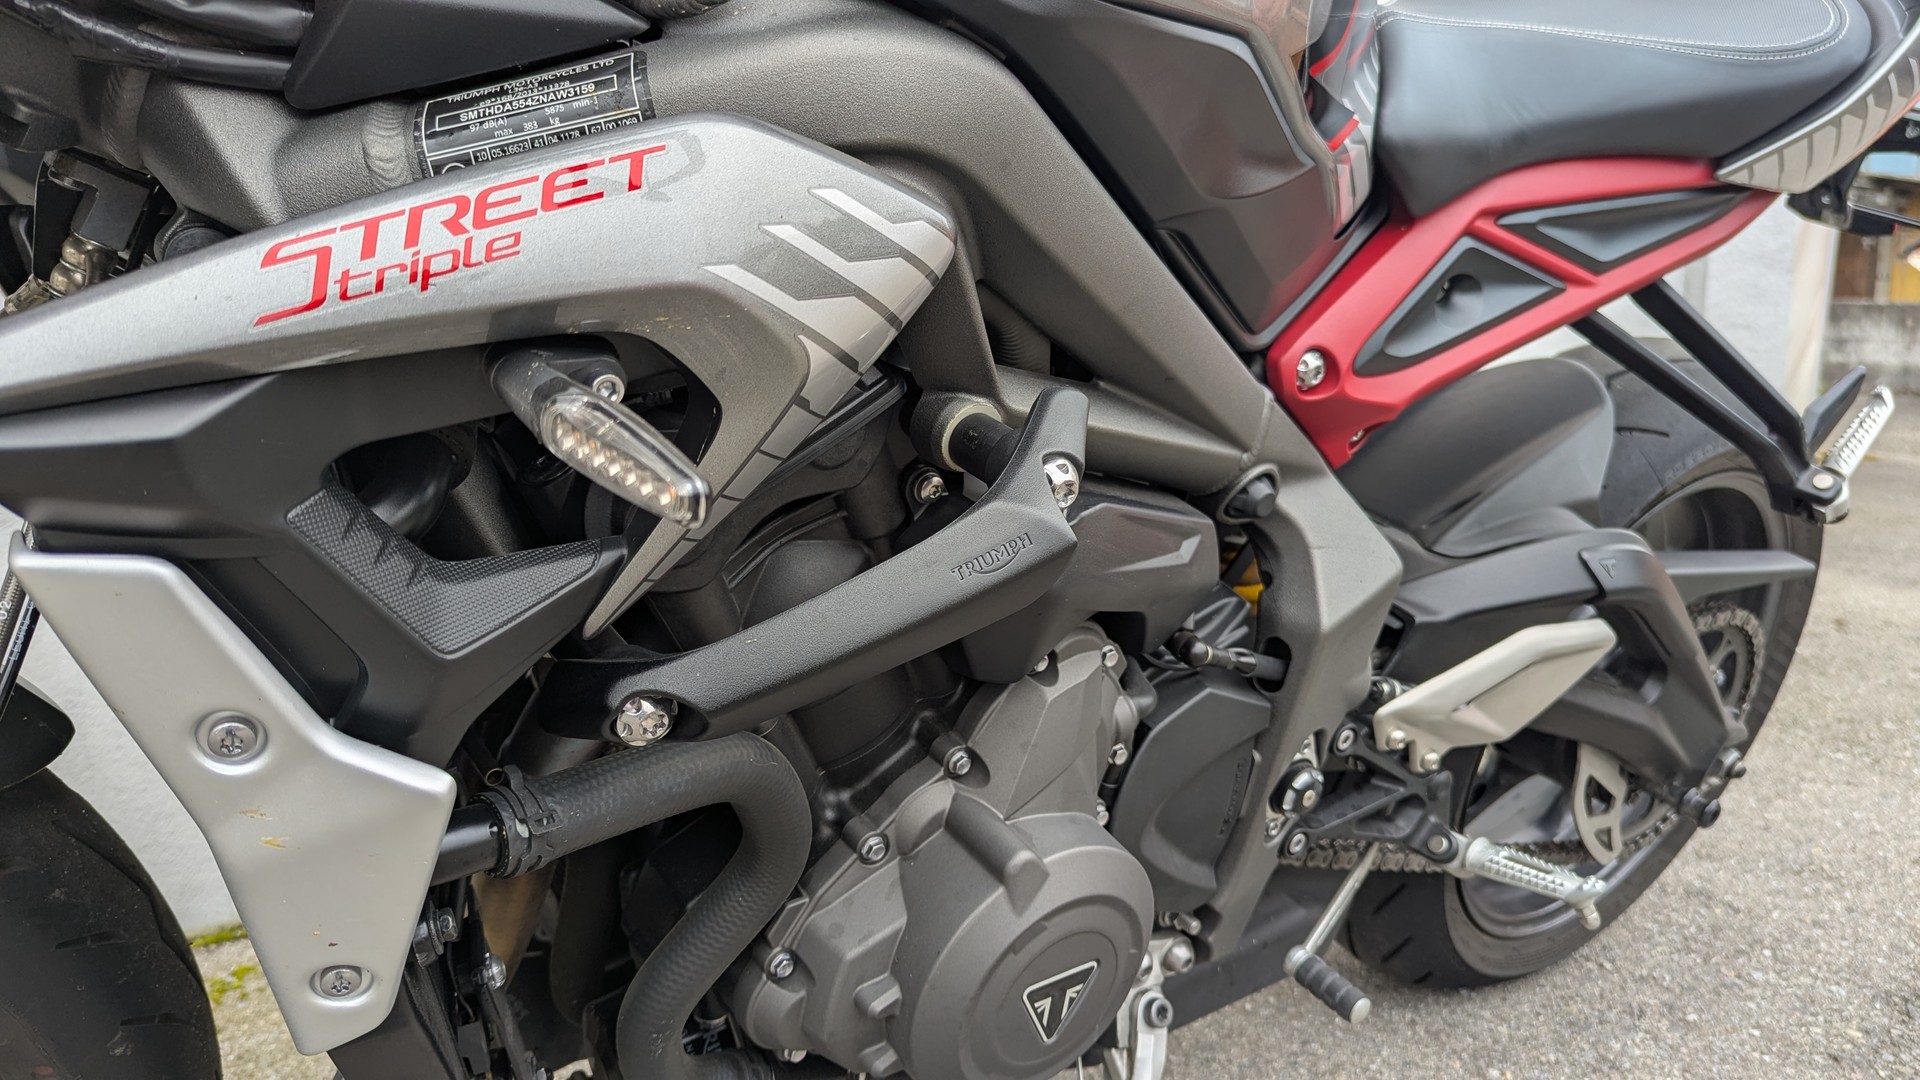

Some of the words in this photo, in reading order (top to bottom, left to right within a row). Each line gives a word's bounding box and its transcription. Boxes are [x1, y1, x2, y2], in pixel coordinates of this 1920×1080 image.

[447, 87, 500, 103] TRIUMPH
[504, 65, 589, 90] MOTORCYCLES
[592, 59, 614, 69] LTD
[459, 83, 595, 121] SMTHDA554ZNAW3159
[470, 124, 480, 133] 97
[483, 117, 508, 129] dB(A)
[544, 105, 565, 115] 5875
[573, 97, 598, 109] min-1
[494, 128, 513, 138] max
[522, 121, 538, 131] 383
[549, 117, 560, 126] kg
[477, 151, 488, 162] 10
[492, 142, 529, 158] 05.16623
[534, 138, 544, 148] 41
[606, 117, 637, 130] 001069
[253, 145, 667, 327] STREET
[334, 231, 522, 301] triple
[950, 532, 1032, 580] TRIUMPH
